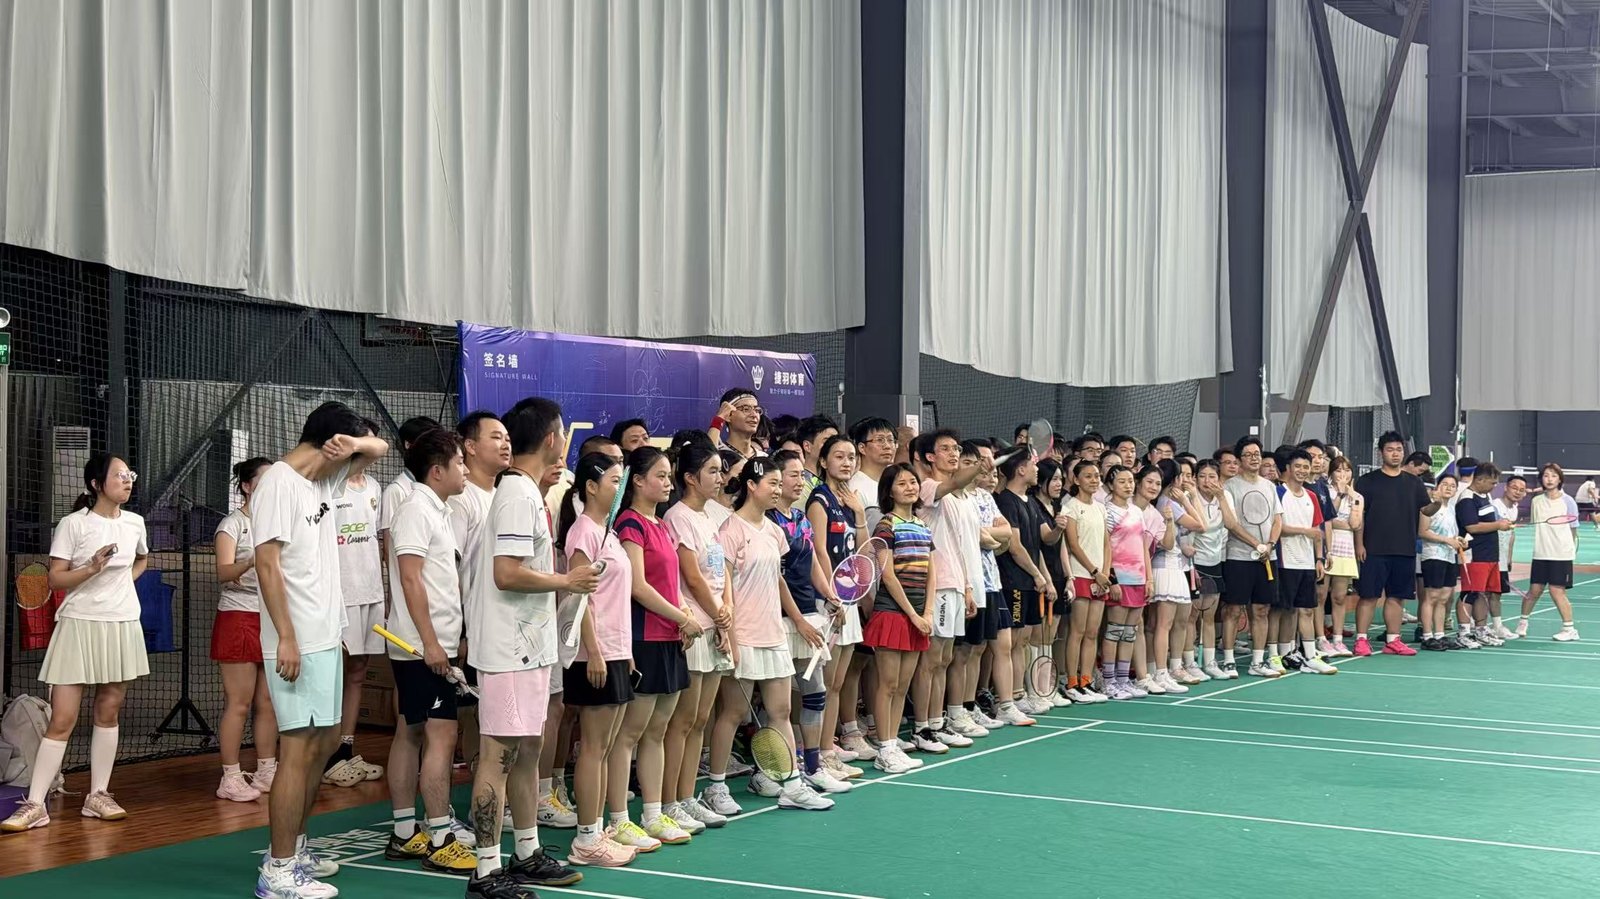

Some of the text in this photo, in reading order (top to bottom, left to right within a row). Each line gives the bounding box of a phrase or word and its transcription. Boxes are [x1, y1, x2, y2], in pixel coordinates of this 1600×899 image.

[483, 352, 518, 368] 签名墙
[774, 370, 805, 386] 捷羽体育
[340, 522, 369, 534] acer
[1012, 601, 1021, 623] YONEX
